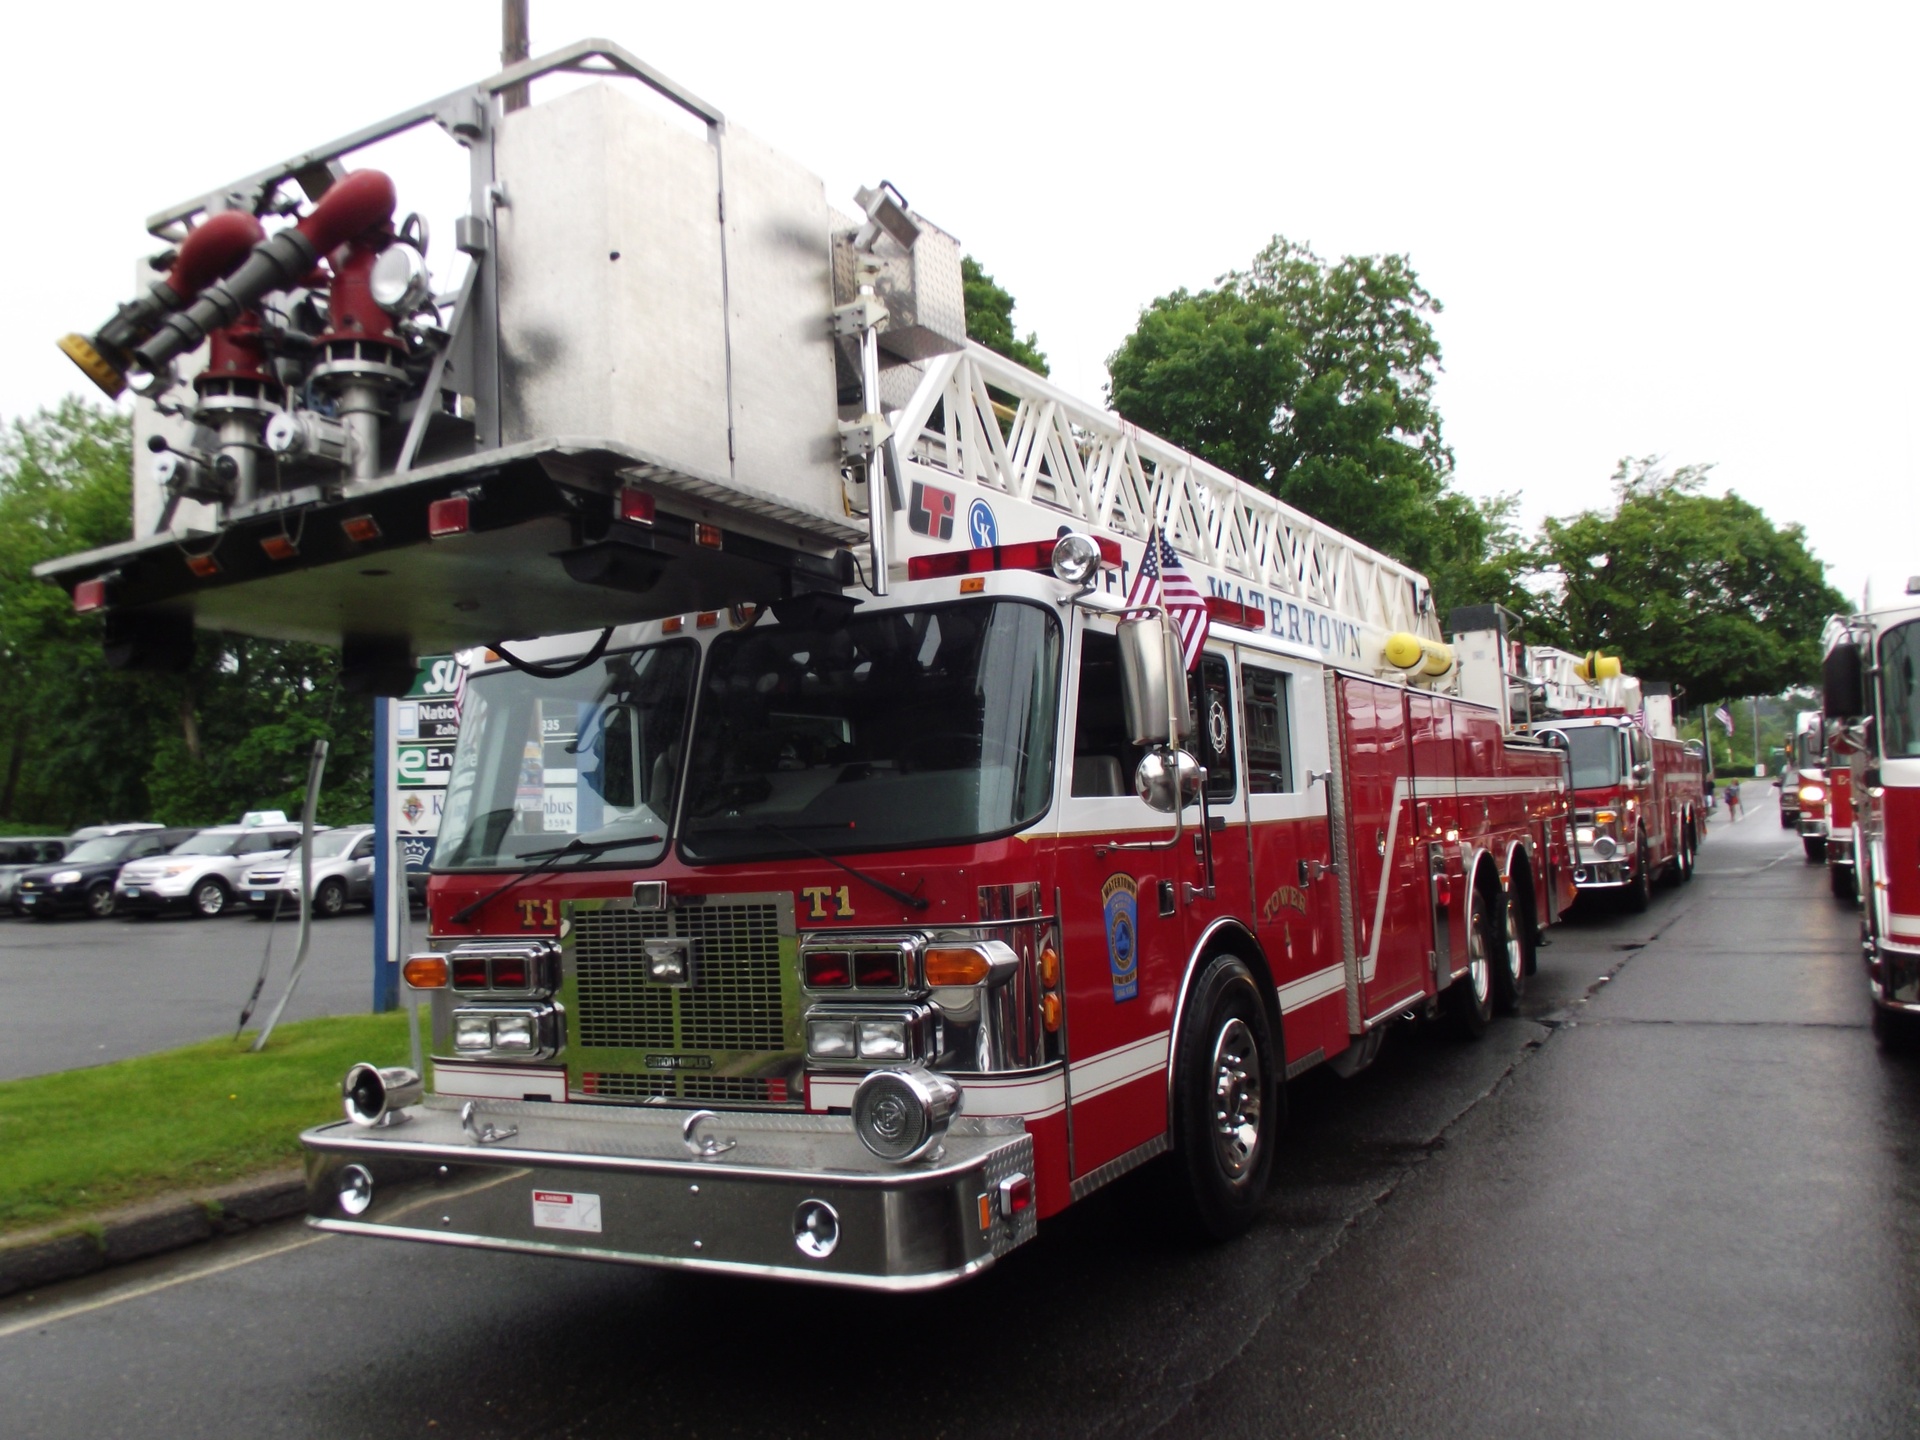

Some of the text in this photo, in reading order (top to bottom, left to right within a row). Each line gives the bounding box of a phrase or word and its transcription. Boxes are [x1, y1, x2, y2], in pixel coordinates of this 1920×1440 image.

[419, 704, 456, 720] Natio
[427, 749, 453, 767] En
[1103, 876, 1136, 899] WATERTOWN
[518, 899, 557, 926] T1
[803, 885, 856, 917] T1
[1263, 885, 1306, 925] TOWER
